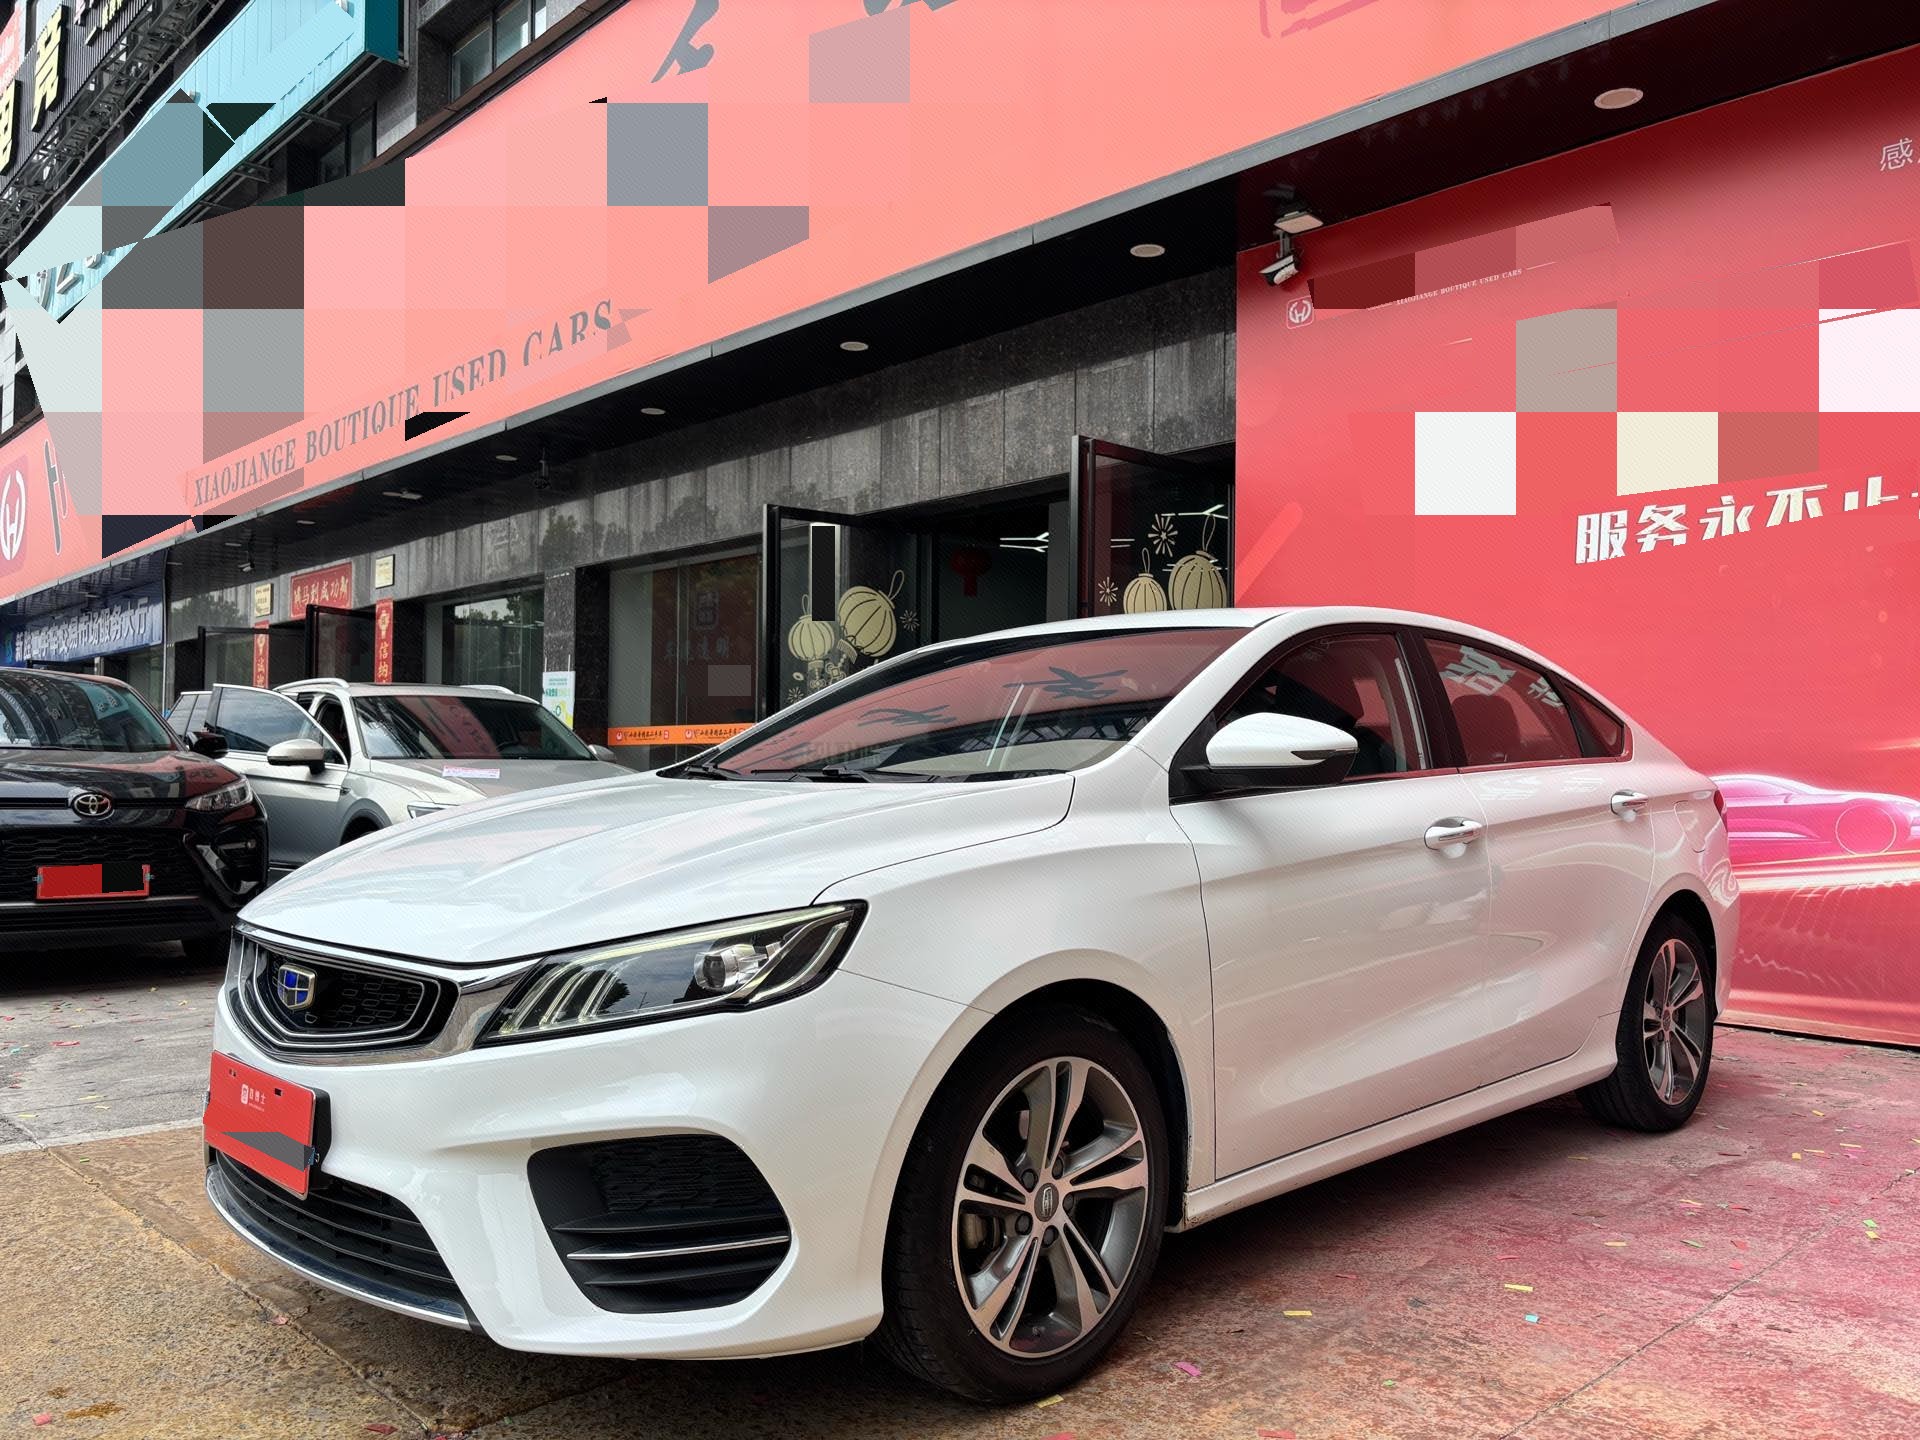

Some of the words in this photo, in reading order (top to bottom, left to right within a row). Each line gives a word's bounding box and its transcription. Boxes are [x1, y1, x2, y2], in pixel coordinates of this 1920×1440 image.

[1880, 137, 1920, 172] 感
[194, 438, 297, 507] XIAOJIANGE
[305, 384, 420, 464] BOUTIQUE
[432, 348, 506, 407] USED
[1575, 475, 1920, 564] 服务永不止
